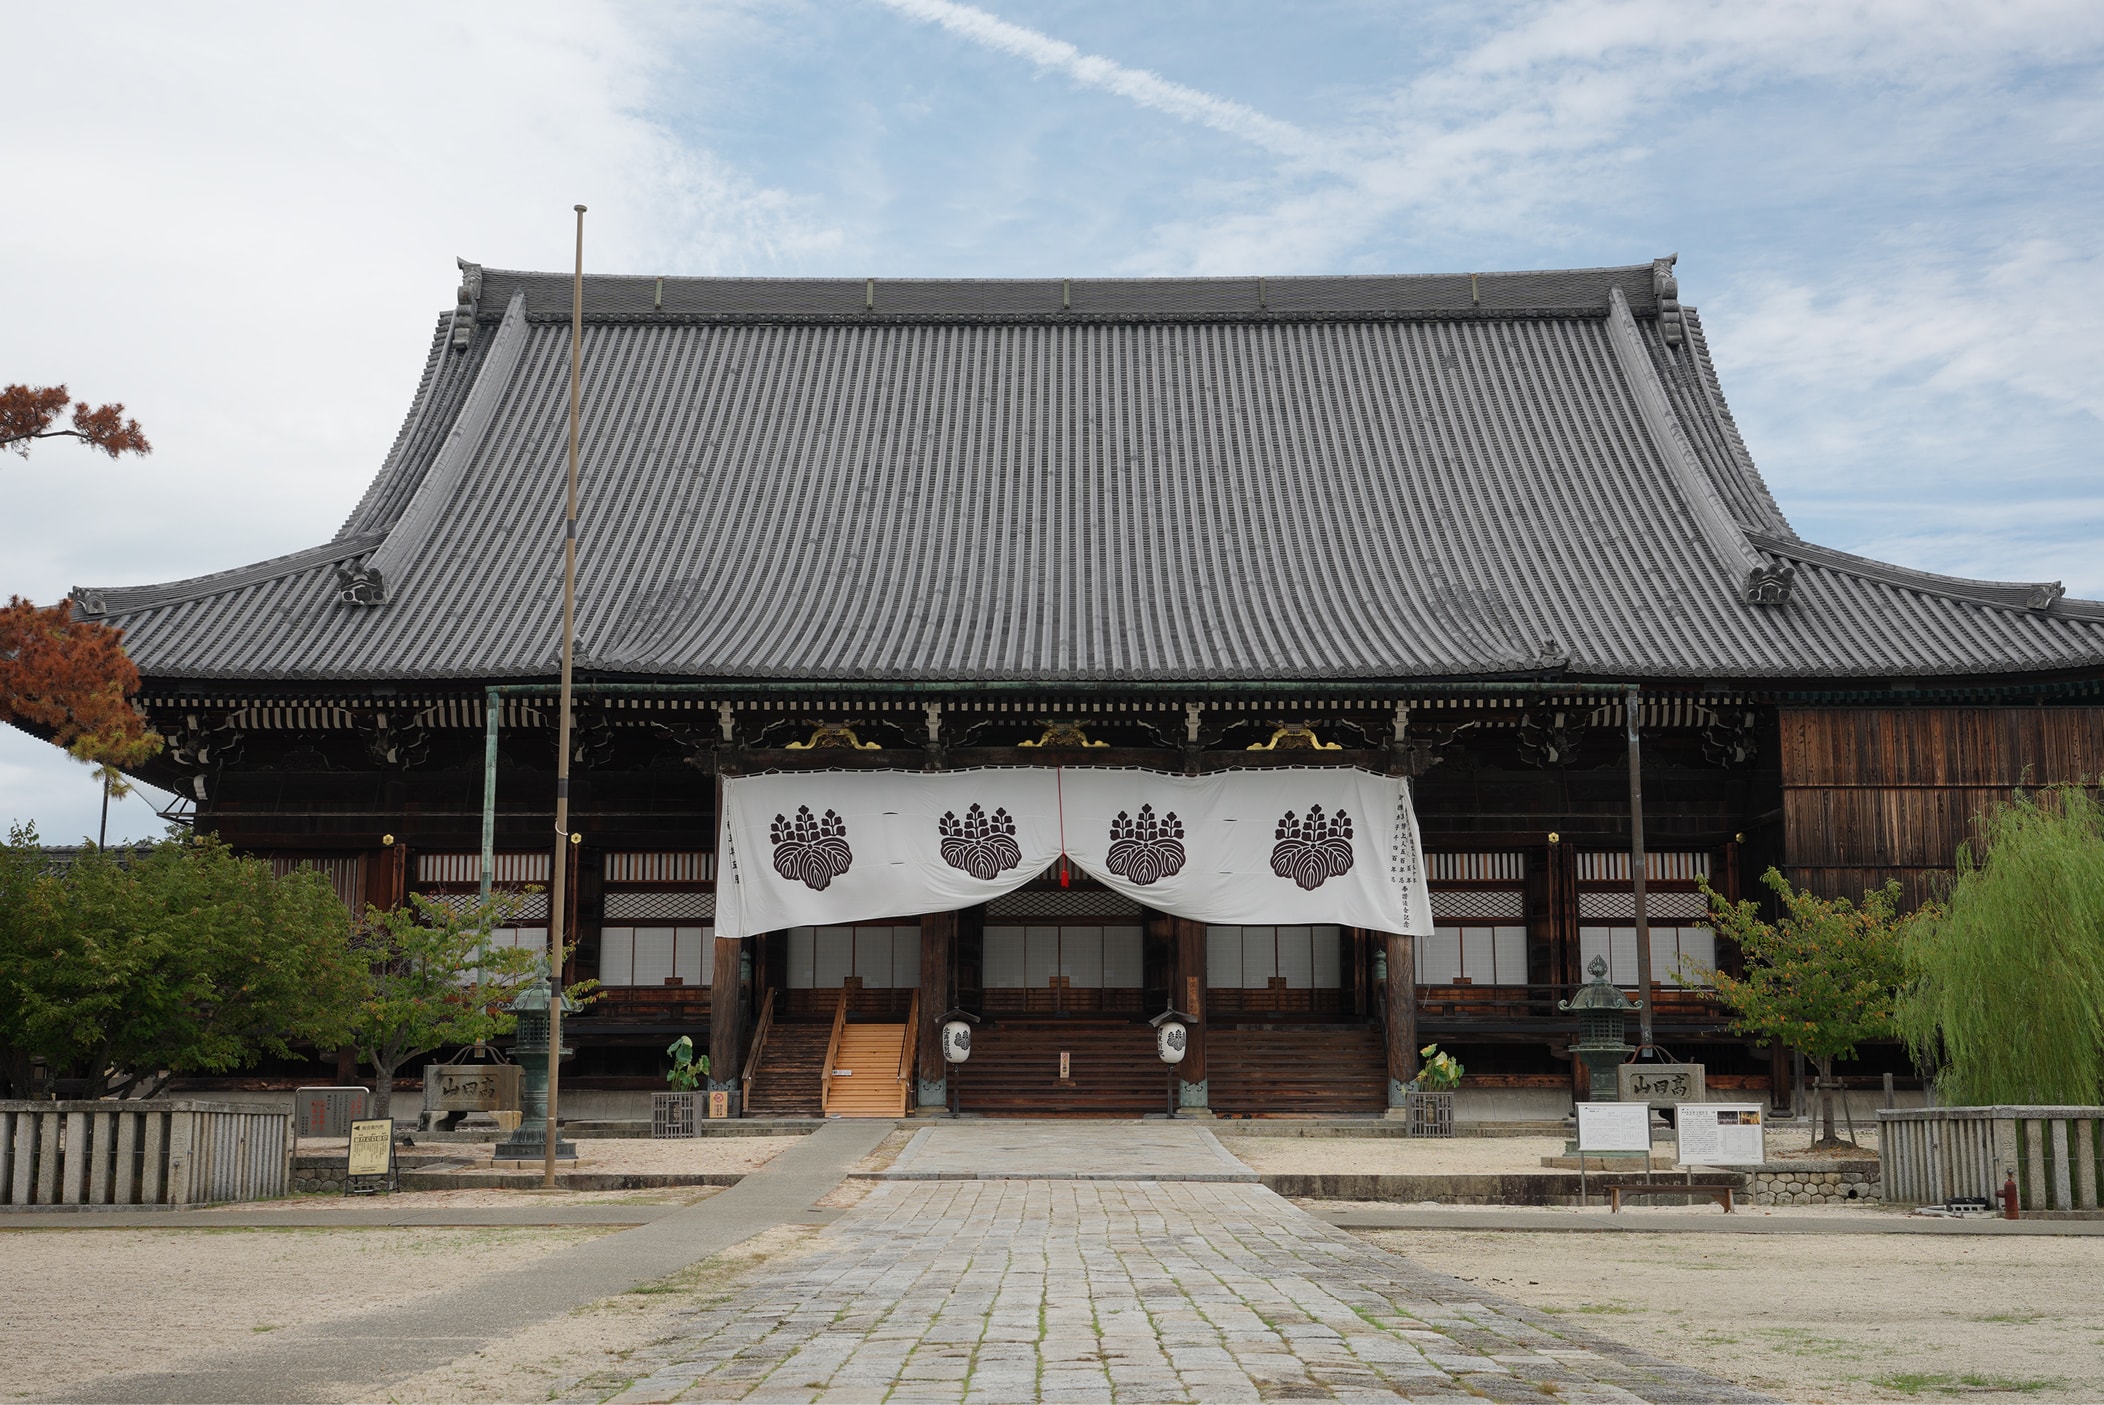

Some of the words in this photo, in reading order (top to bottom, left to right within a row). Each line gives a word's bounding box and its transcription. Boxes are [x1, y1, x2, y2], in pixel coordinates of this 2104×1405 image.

[442, 1077, 496, 1098] 高田山
[1634, 1075, 1687, 1097] 高田山
